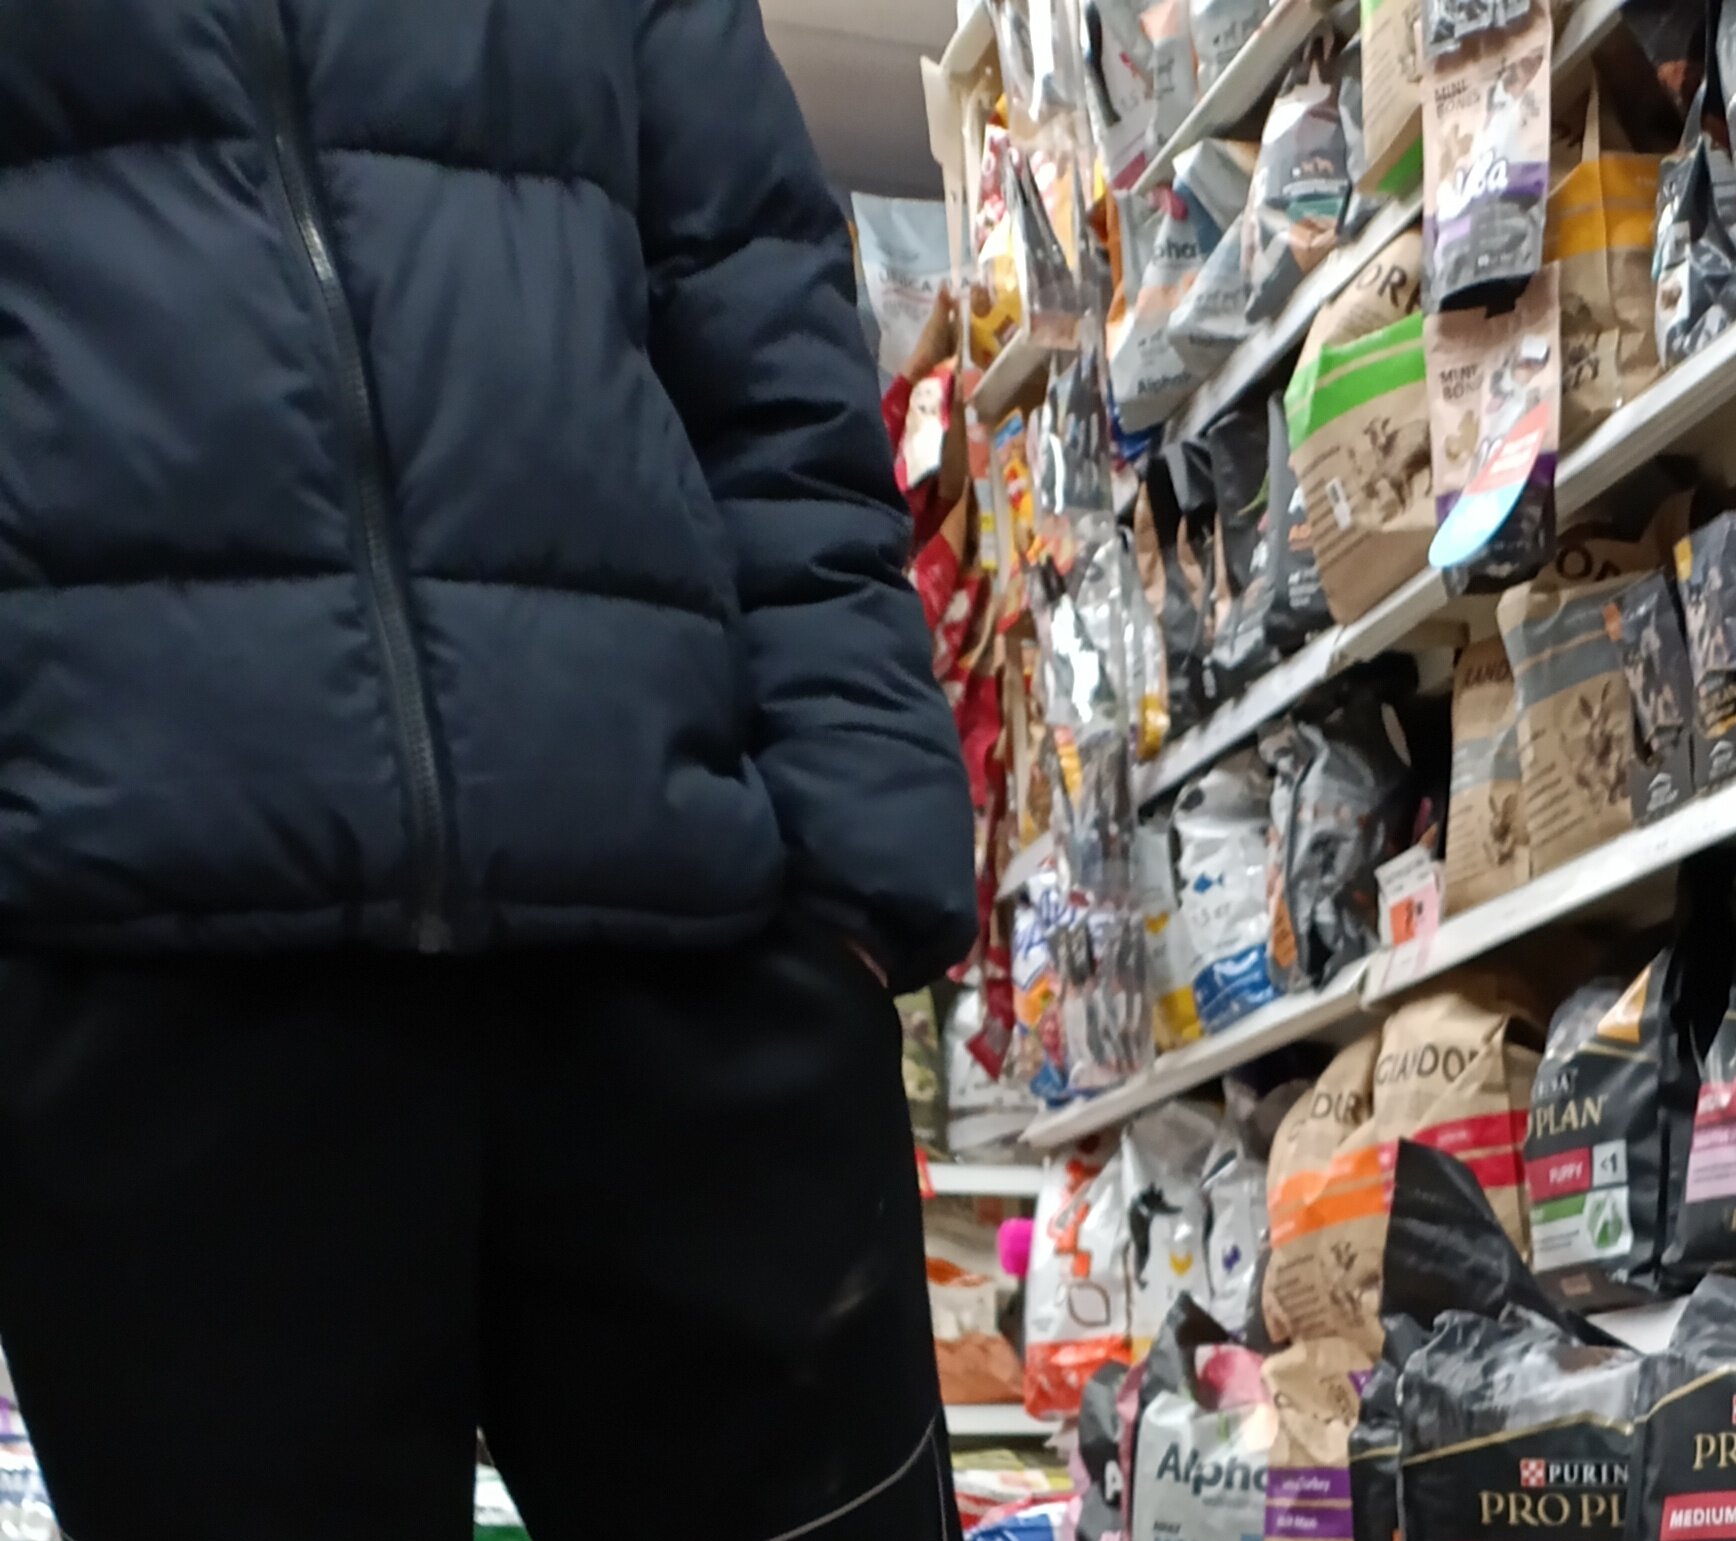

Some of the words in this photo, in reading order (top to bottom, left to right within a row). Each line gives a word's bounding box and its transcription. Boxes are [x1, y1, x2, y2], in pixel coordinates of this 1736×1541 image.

[1548, 1463, 1630, 1485] PURIN
[1478, 1490, 1572, 1527] PRO
[1580, 1492, 1627, 1529] PL
